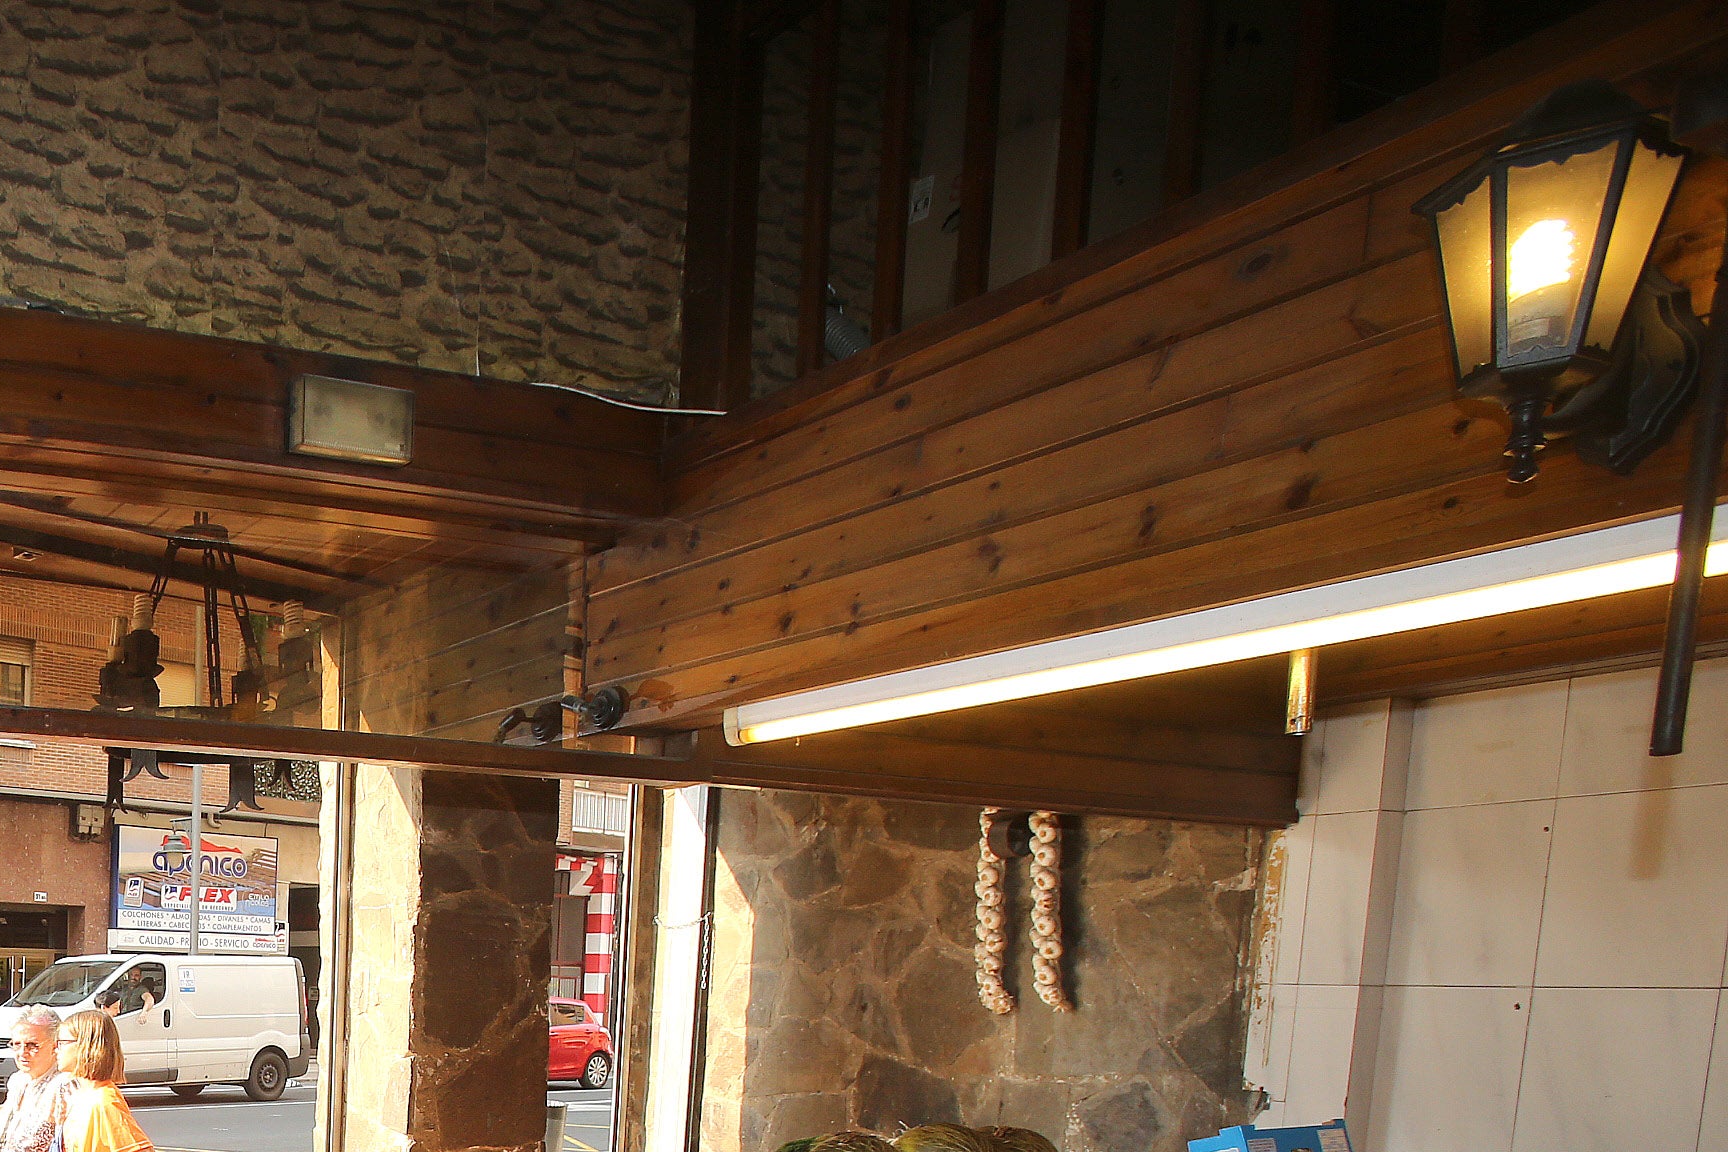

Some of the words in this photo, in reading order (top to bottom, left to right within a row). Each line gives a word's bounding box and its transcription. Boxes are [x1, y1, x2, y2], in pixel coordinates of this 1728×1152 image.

[122, 910, 164, 919] COLCHONES
[171, 912, 211, 921] ALMODAS
[217, 915, 243, 923] DIVANES
[250, 916, 271, 924] CAMAS
[212, 923, 262, 932] COMPLEMENTOS
[139, 935, 175, 945] CALIDAD
[180, 936, 209, 946] PRIO
[215, 937, 250, 948] SERVICIO
